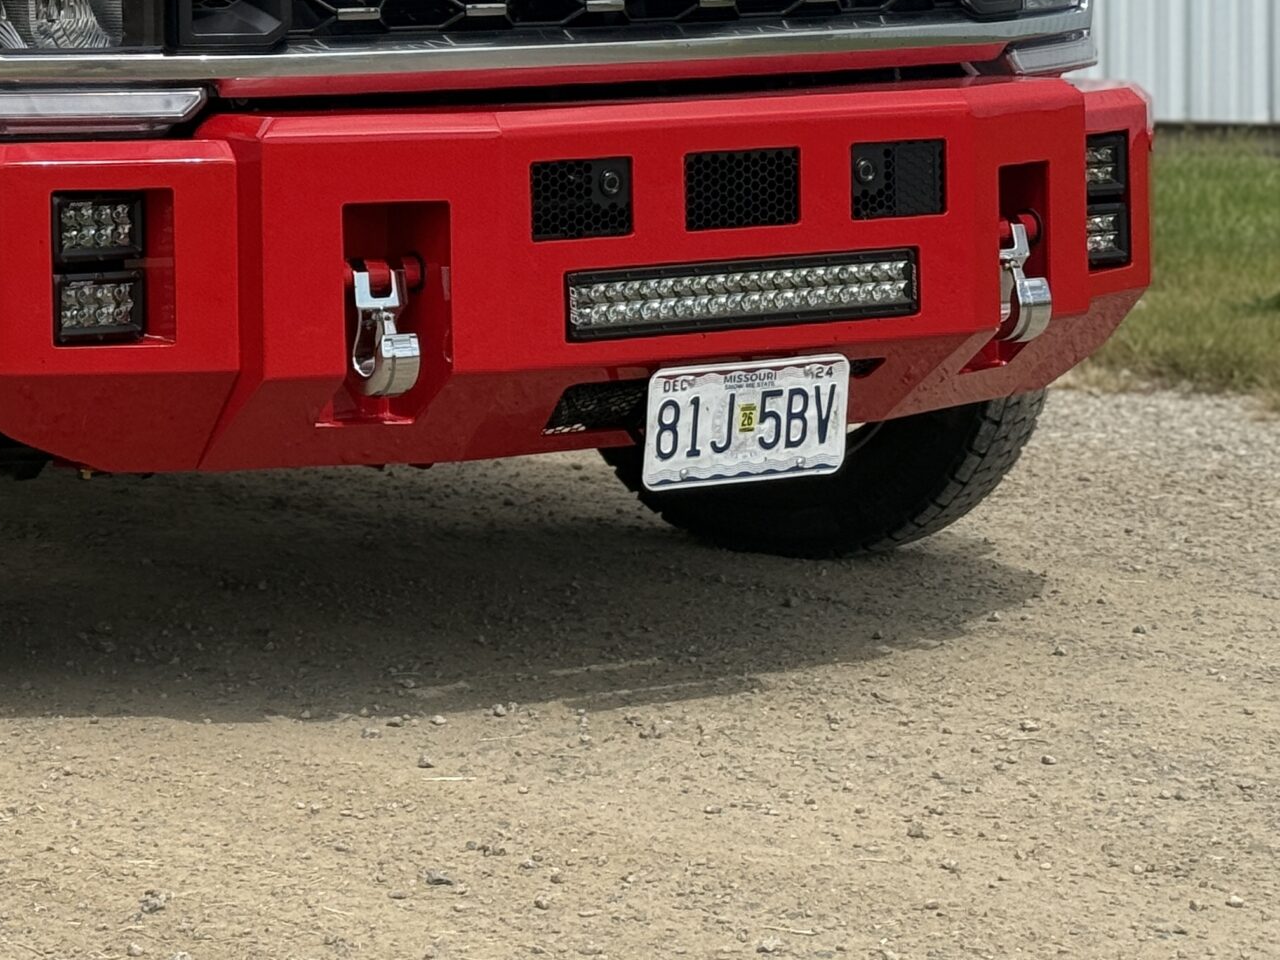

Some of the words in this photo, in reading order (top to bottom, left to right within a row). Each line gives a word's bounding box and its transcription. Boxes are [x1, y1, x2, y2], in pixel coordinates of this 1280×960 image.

[724, 371, 777, 384] MISSOURI
[664, 380, 688, 393] DEC
[656, 392, 736, 460] 81J
[758, 383, 836, 451] 5BV
[741, 411, 754, 427] 26
